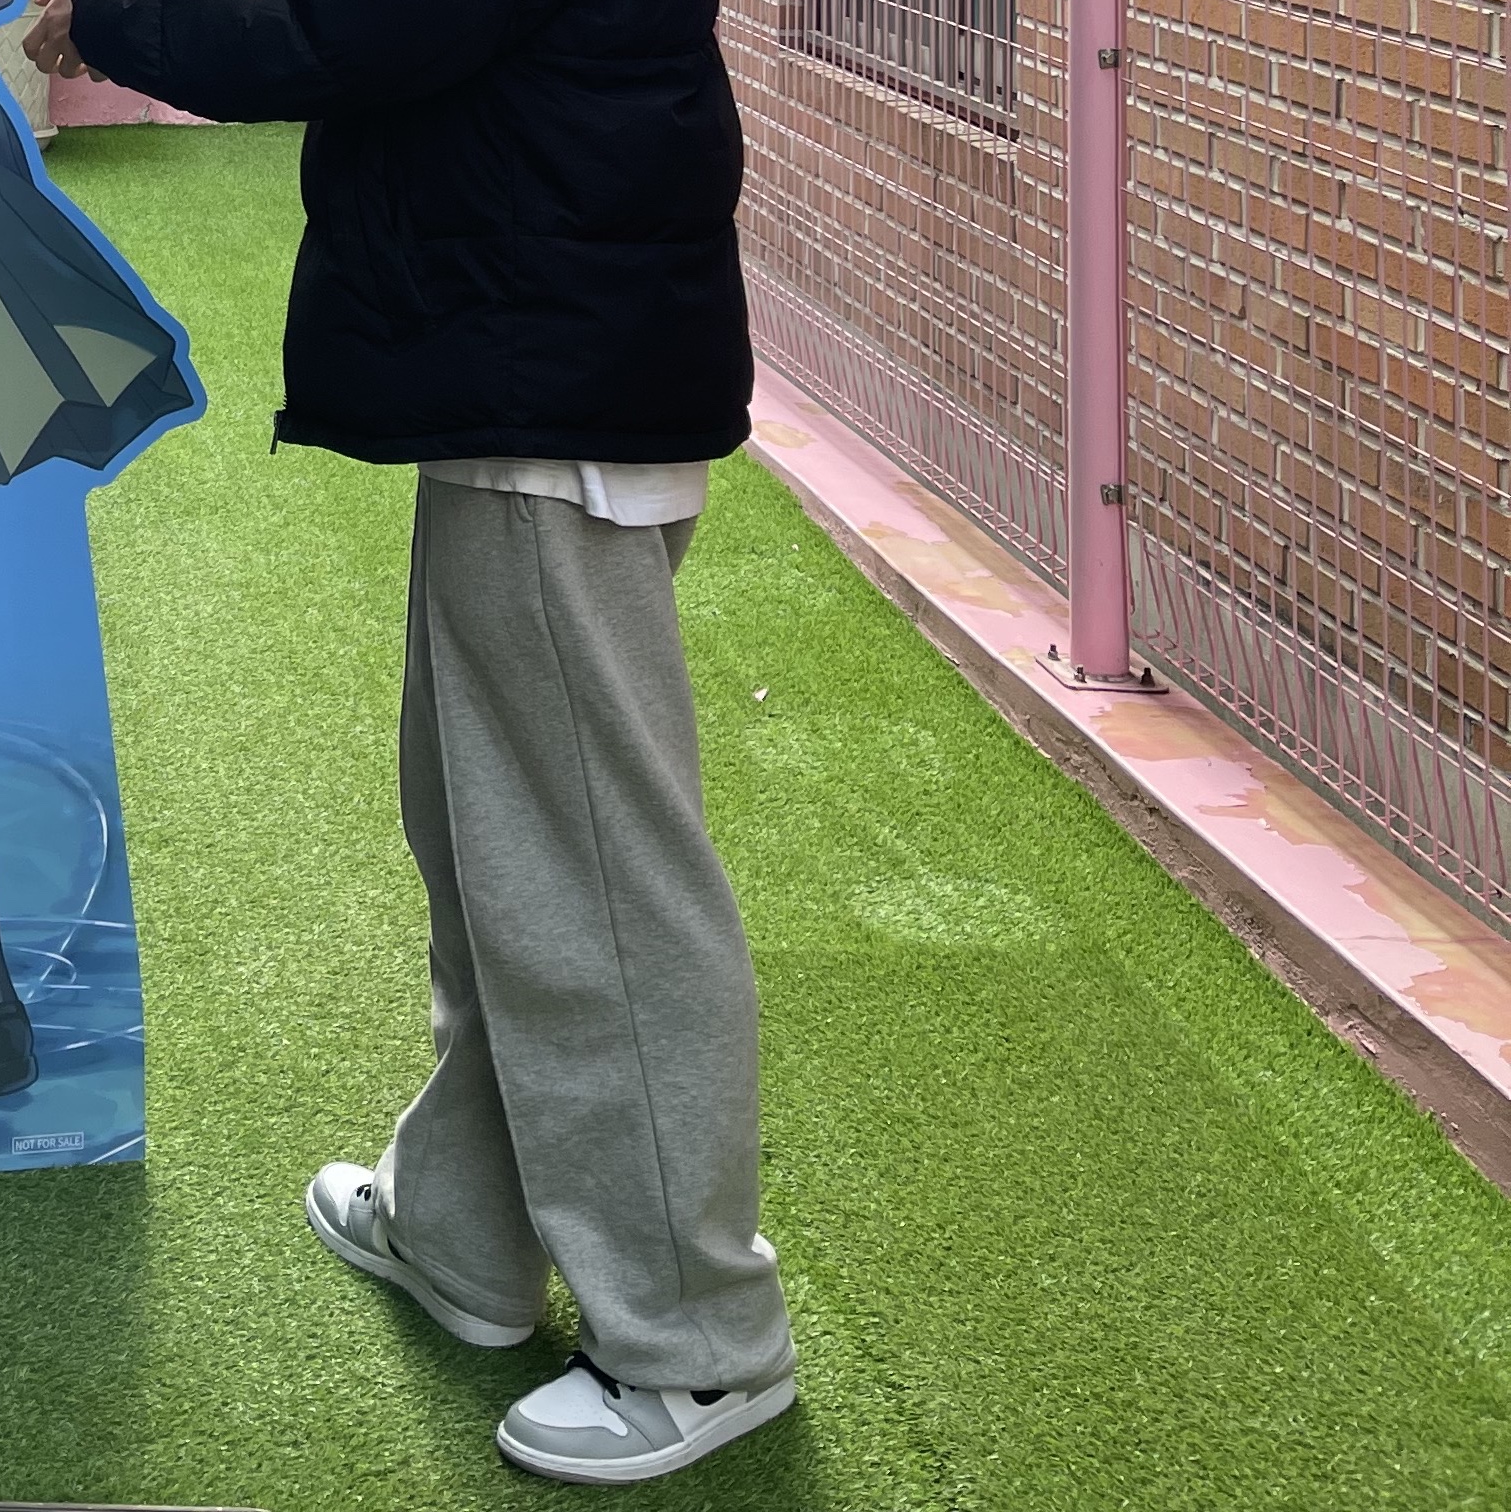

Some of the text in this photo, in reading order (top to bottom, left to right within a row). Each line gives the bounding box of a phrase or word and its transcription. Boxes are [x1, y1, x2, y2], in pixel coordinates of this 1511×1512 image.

[15, 1136, 80, 1151] NOT FOR SALE
